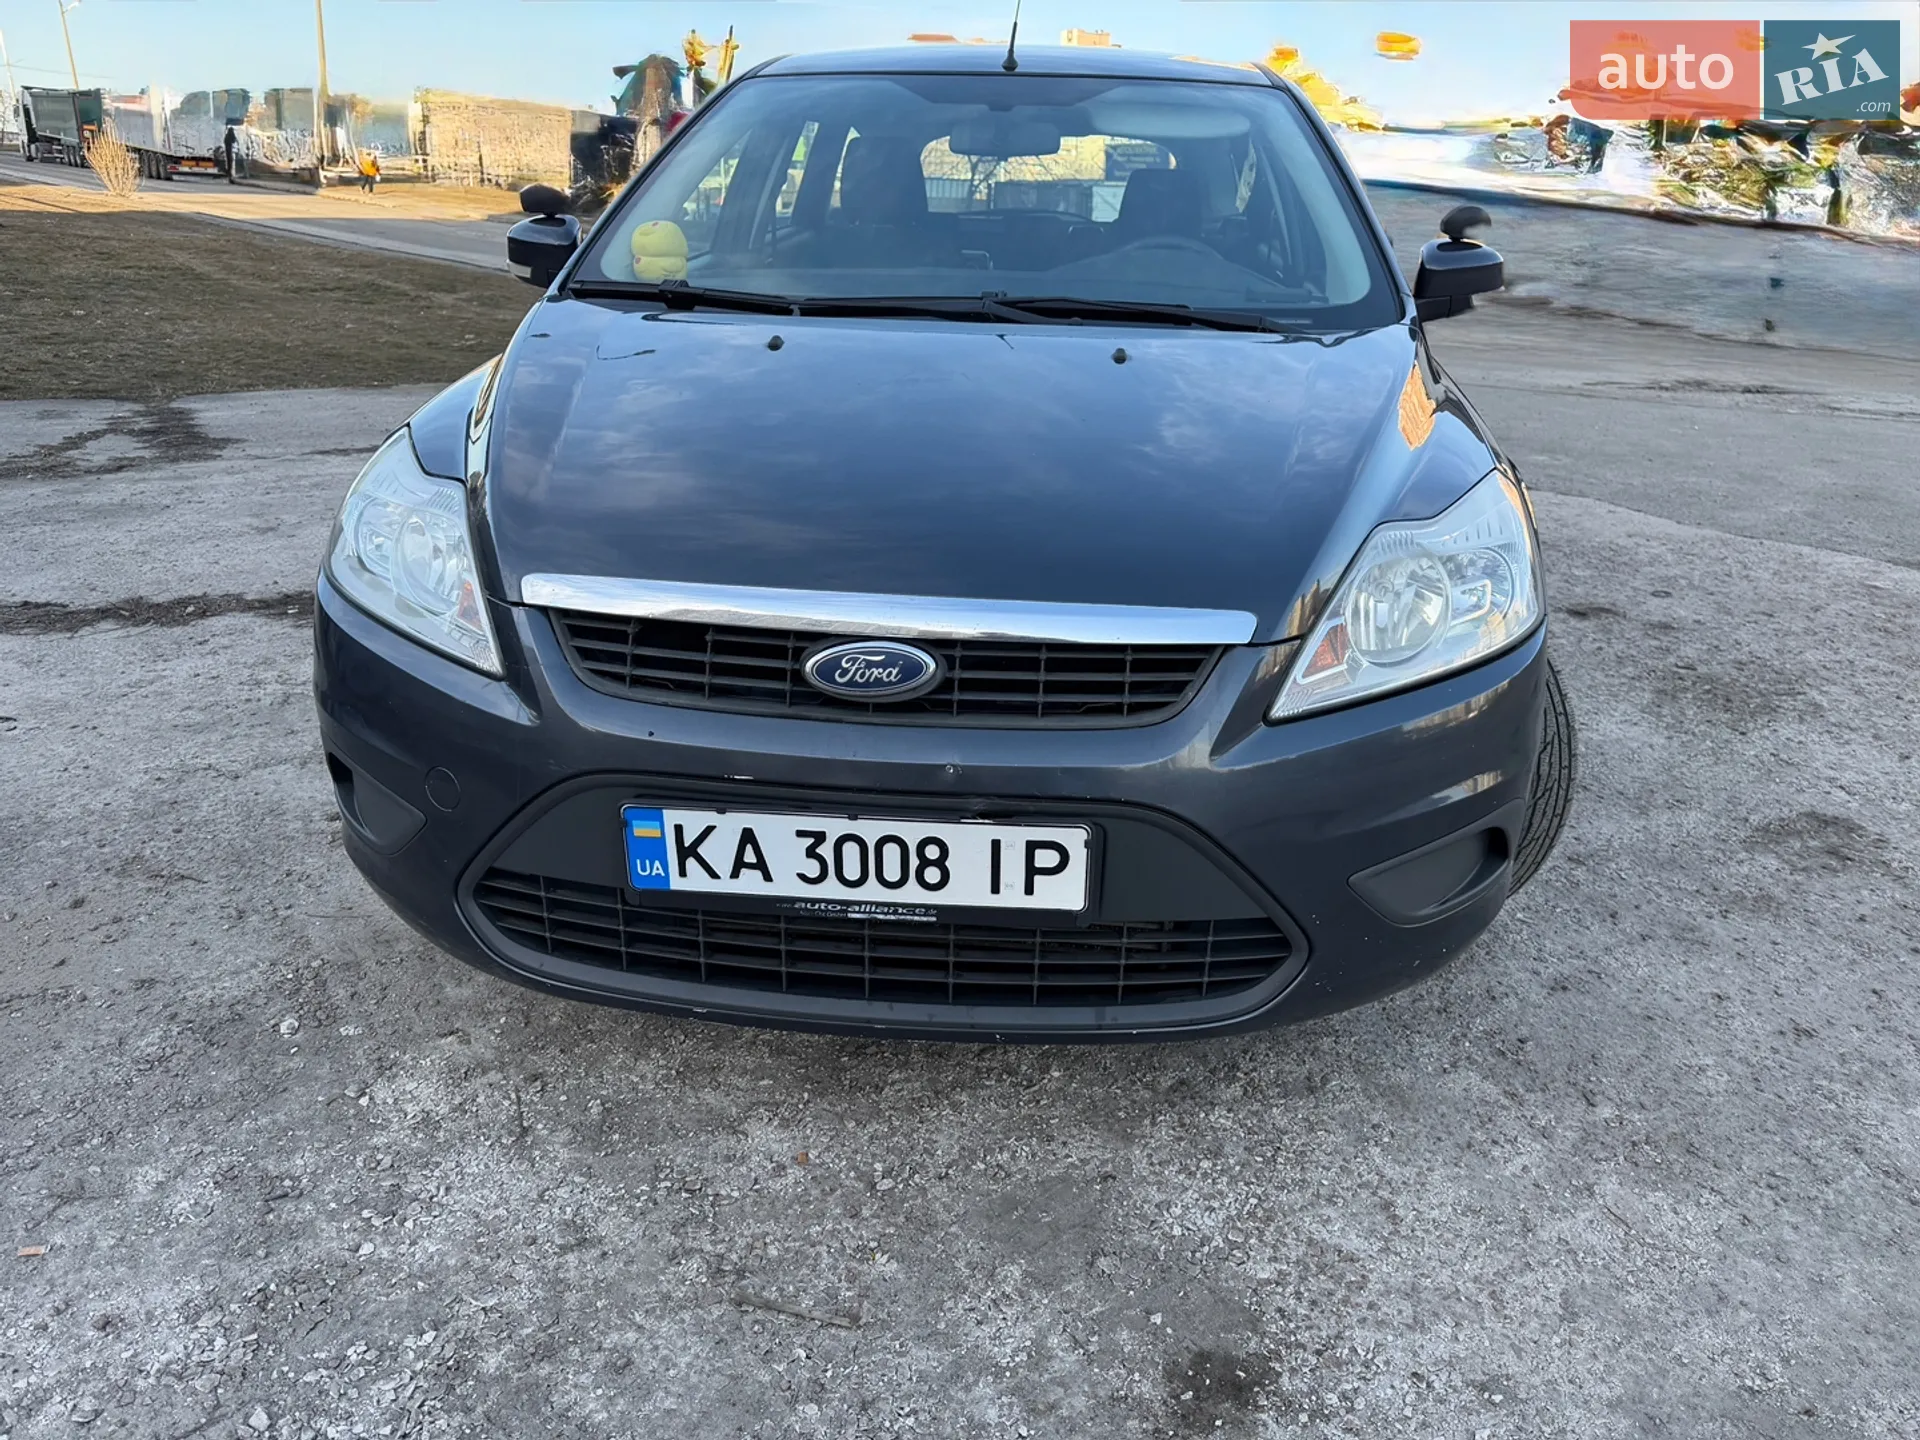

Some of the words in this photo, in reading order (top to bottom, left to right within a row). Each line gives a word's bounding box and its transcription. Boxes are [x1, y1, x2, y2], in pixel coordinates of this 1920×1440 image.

[834, 654, 903, 683] Ford
[636, 859, 665, 877] UA
[674, 823, 774, 882] KA
[795, 829, 951, 892] 3008
[990, 838, 1071, 896] IP
